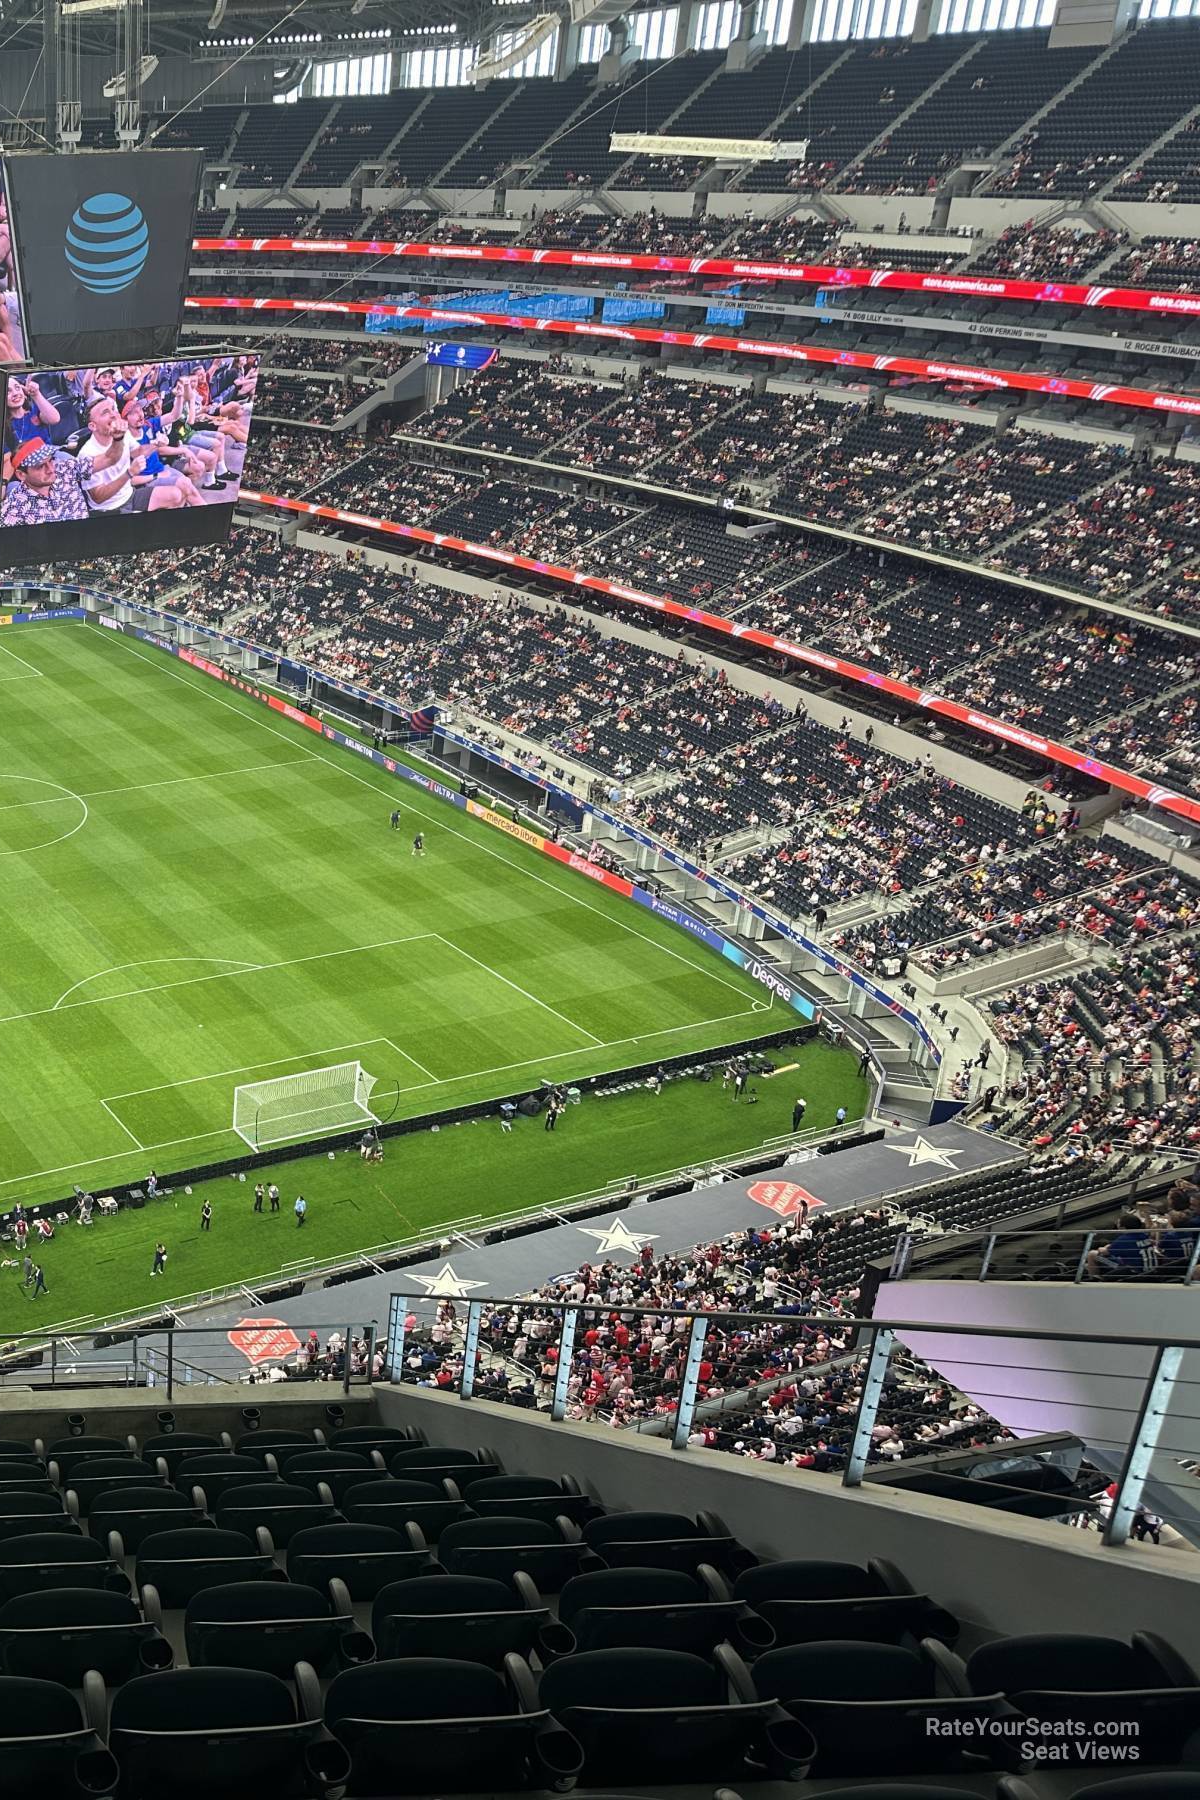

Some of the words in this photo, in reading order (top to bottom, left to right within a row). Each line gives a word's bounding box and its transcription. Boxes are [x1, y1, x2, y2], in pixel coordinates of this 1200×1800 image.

[852, 312, 865, 320] BOB
[866, 314, 881, 323] LILLY
[979, 326, 993, 334] DON
[995, 327, 1023, 337] PERKINS
[1124, 341, 1133, 350] 12
[1135, 342, 1161, 352] ROGER
[344, 738, 373, 759] ARLINGTON
[434, 785, 456, 801] ULTRA
[486, 813, 519, 836] mercado
[520, 829, 538, 845] libre
[569, 853, 605, 881] Betano
[658, 902, 678, 917] LATAM
[690, 922, 707, 936] DELTA
[752, 961, 791, 1002] Degree
[270, 1337, 292, 1355] THE
